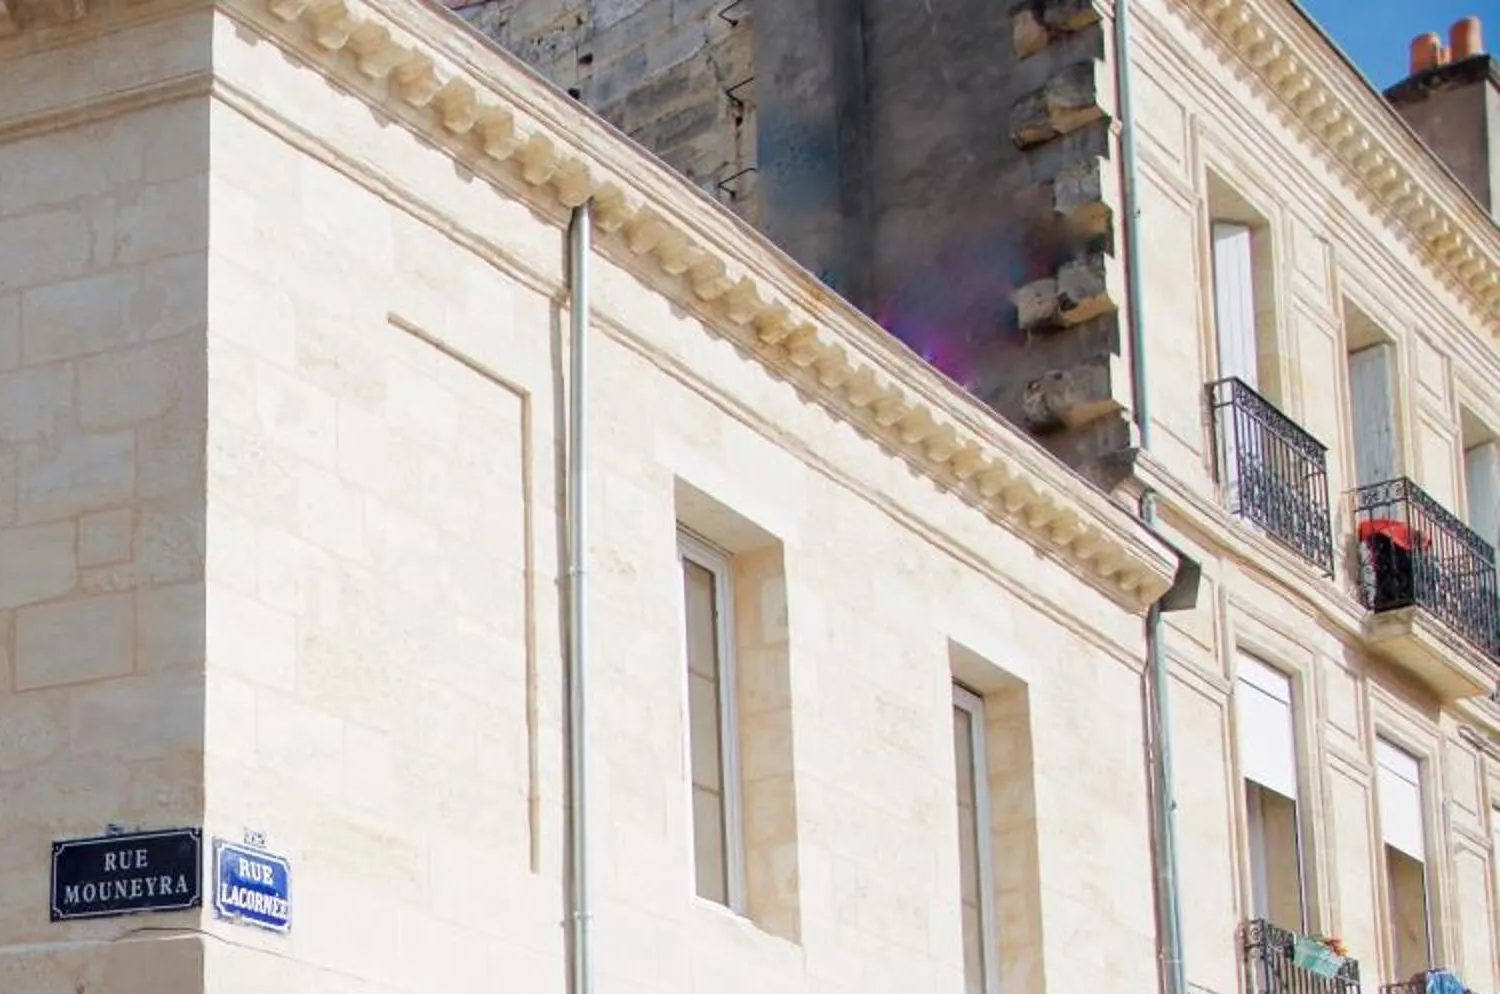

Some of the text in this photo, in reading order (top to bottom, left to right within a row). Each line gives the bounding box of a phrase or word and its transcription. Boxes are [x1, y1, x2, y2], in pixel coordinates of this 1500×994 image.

[104, 848, 148, 872] RUE
[238, 857, 273, 886] RUE
[64, 875, 188, 904] MOUNEYRA
[221, 883, 289, 919] LACORNÉE
